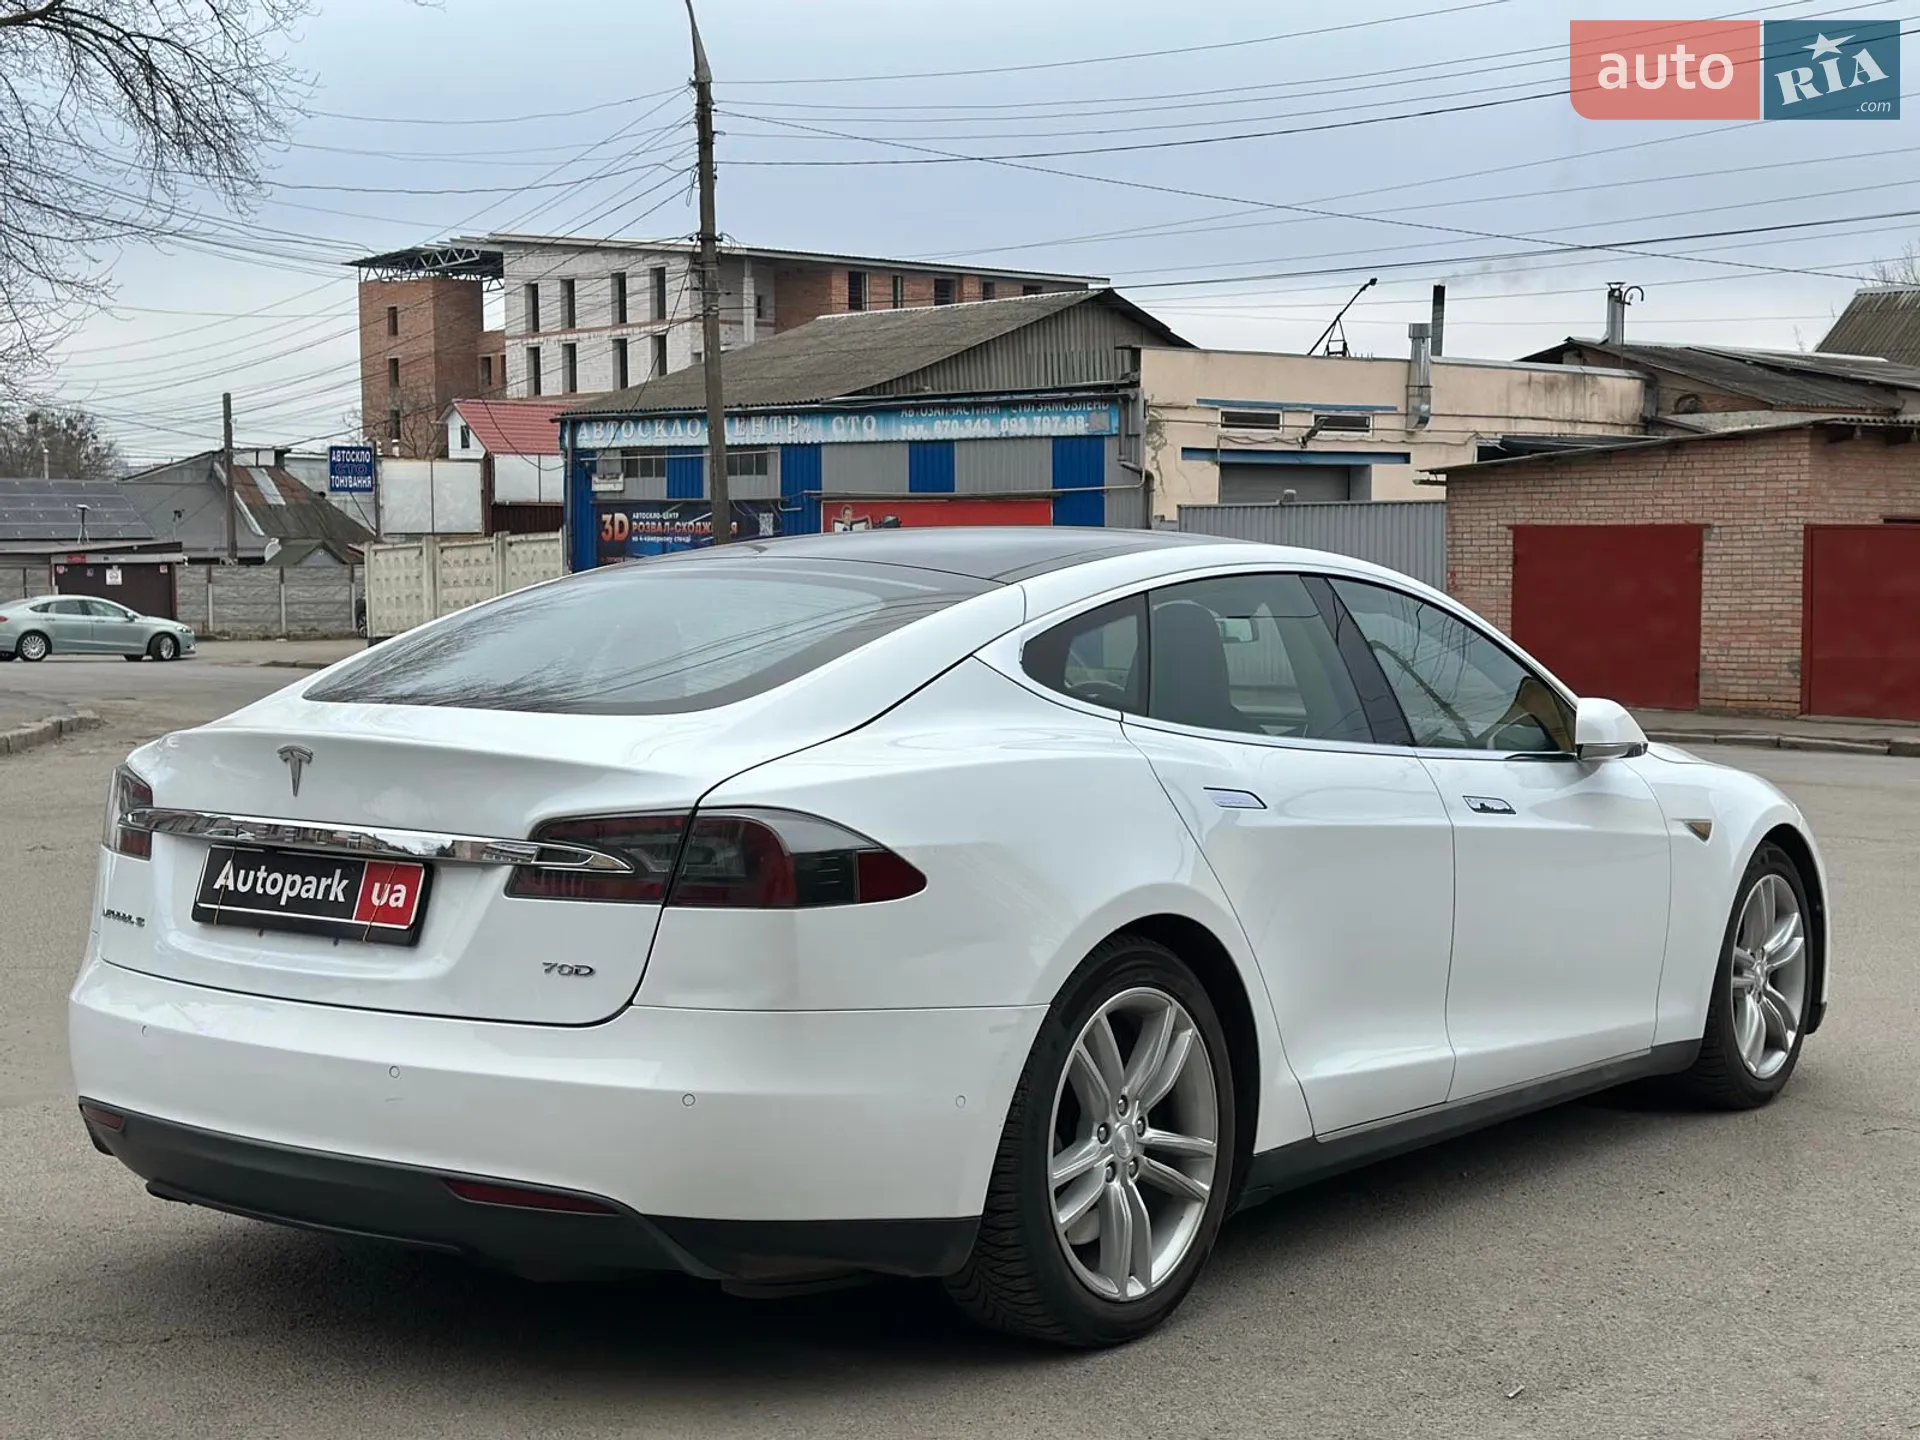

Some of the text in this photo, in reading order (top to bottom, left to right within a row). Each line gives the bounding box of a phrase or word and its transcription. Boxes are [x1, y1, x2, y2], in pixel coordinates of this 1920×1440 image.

[832, 415, 877, 433] СТО
[331, 450, 371, 463] АВТОСКЛО
[331, 475, 372, 488] ТОНУВАННЯ
[601, 512, 629, 541] 3D
[212, 860, 408, 908] Autopark ua
[542, 961, 596, 977] 70D
